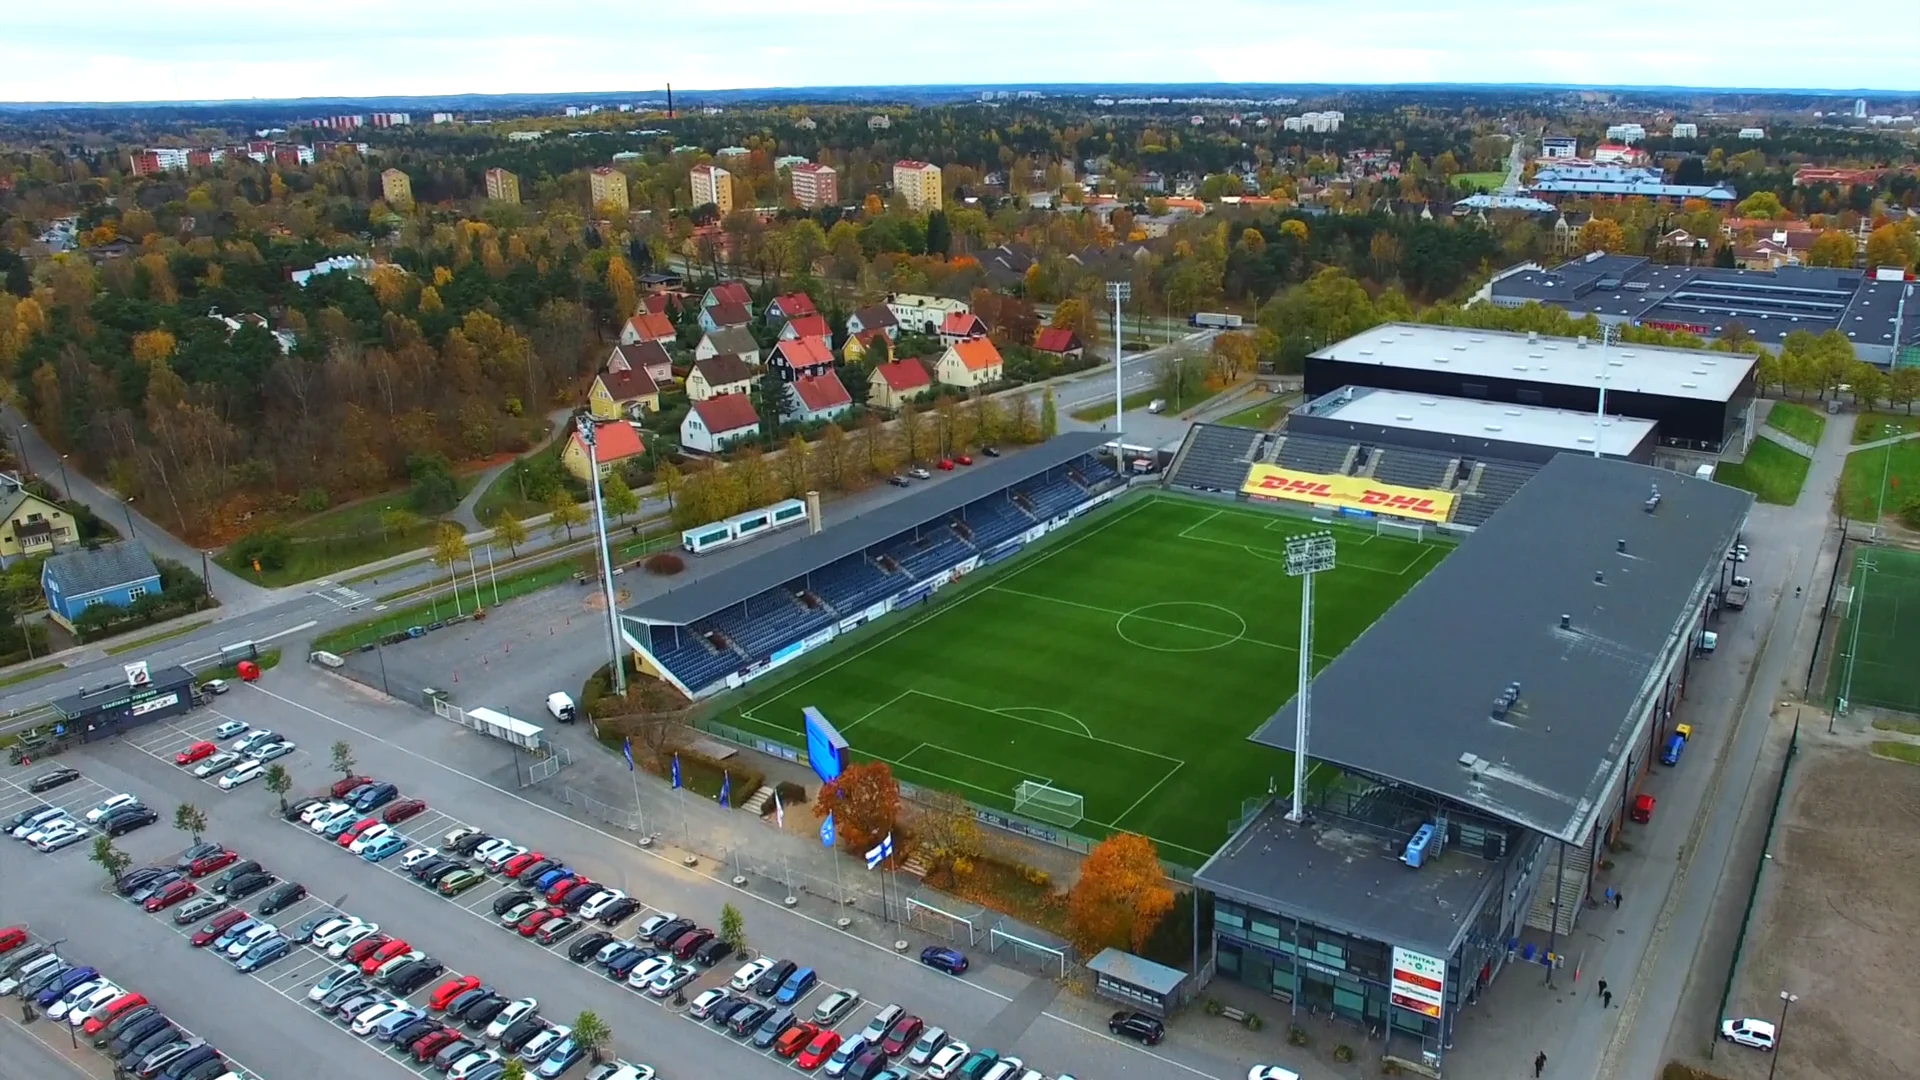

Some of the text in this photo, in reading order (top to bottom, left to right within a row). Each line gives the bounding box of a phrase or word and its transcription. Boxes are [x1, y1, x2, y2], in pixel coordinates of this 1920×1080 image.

[1259, 475, 1436, 514] DHL DHL
[1403, 952, 1436, 966] VERITAS
